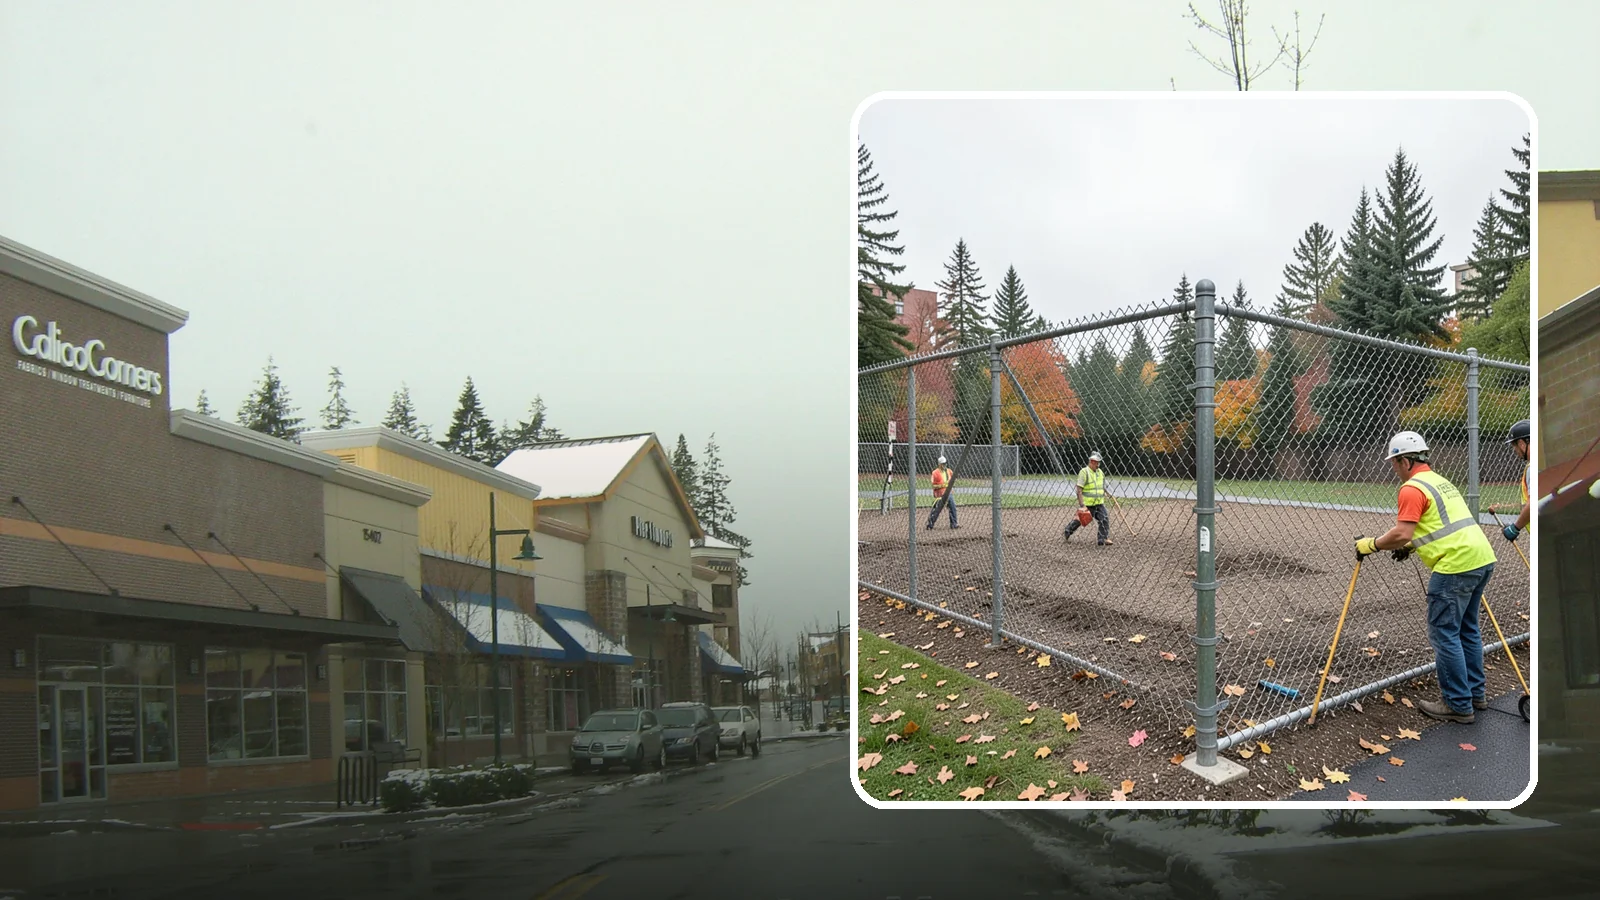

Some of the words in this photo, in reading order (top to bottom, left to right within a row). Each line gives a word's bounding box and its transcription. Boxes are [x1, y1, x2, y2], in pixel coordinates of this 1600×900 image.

[17, 360, 47, 377] FABRICS
[51, 371, 78, 387] WINDOW
[78, 381, 116, 399] TREATMENTS
